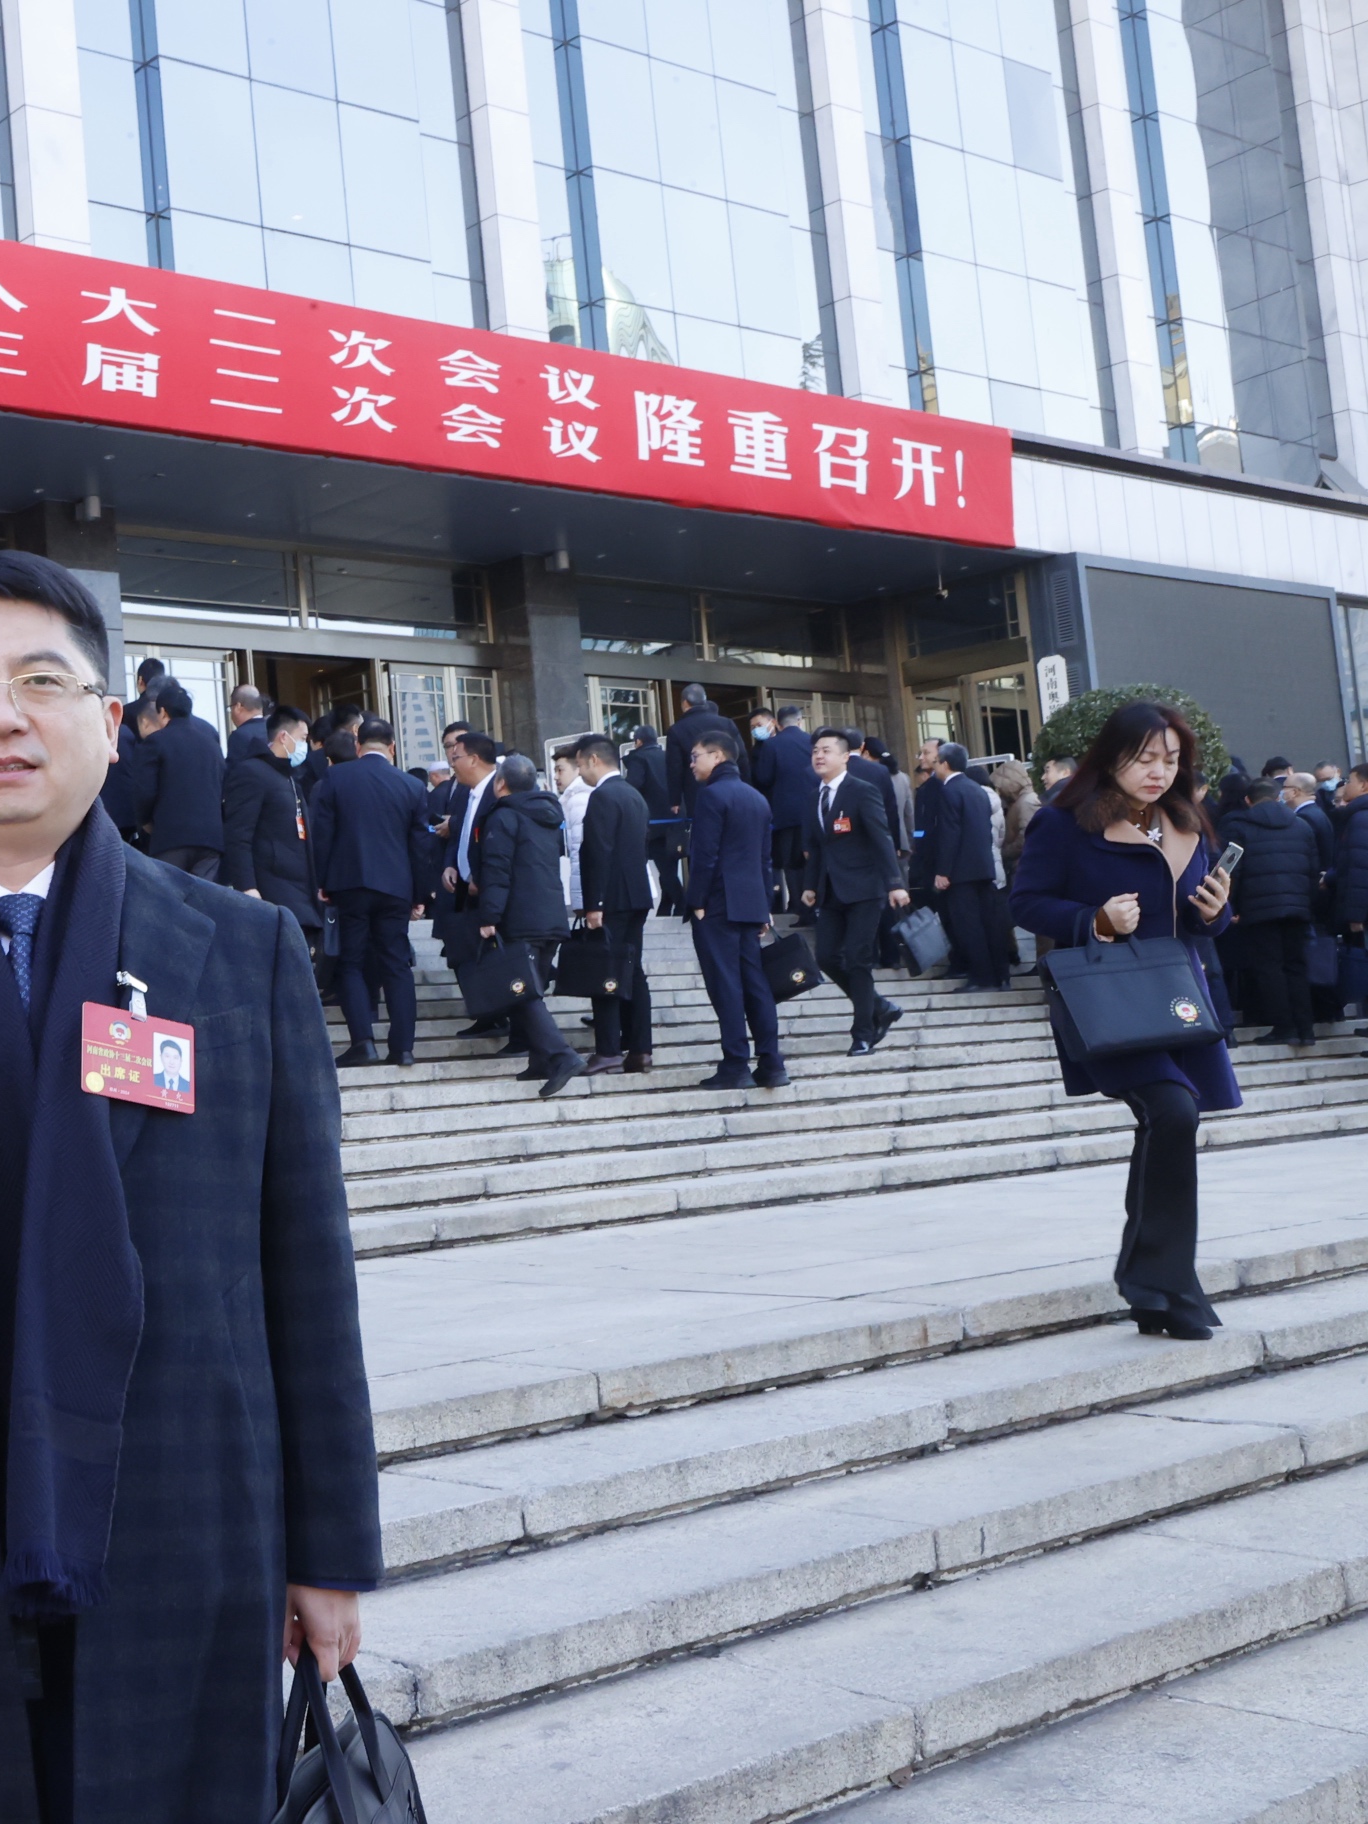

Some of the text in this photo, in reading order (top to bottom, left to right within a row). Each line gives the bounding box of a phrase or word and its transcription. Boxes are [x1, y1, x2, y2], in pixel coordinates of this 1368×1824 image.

[635, 390, 967, 508] 隆重召开!
[100, 1063, 141, 1084] 出席证
